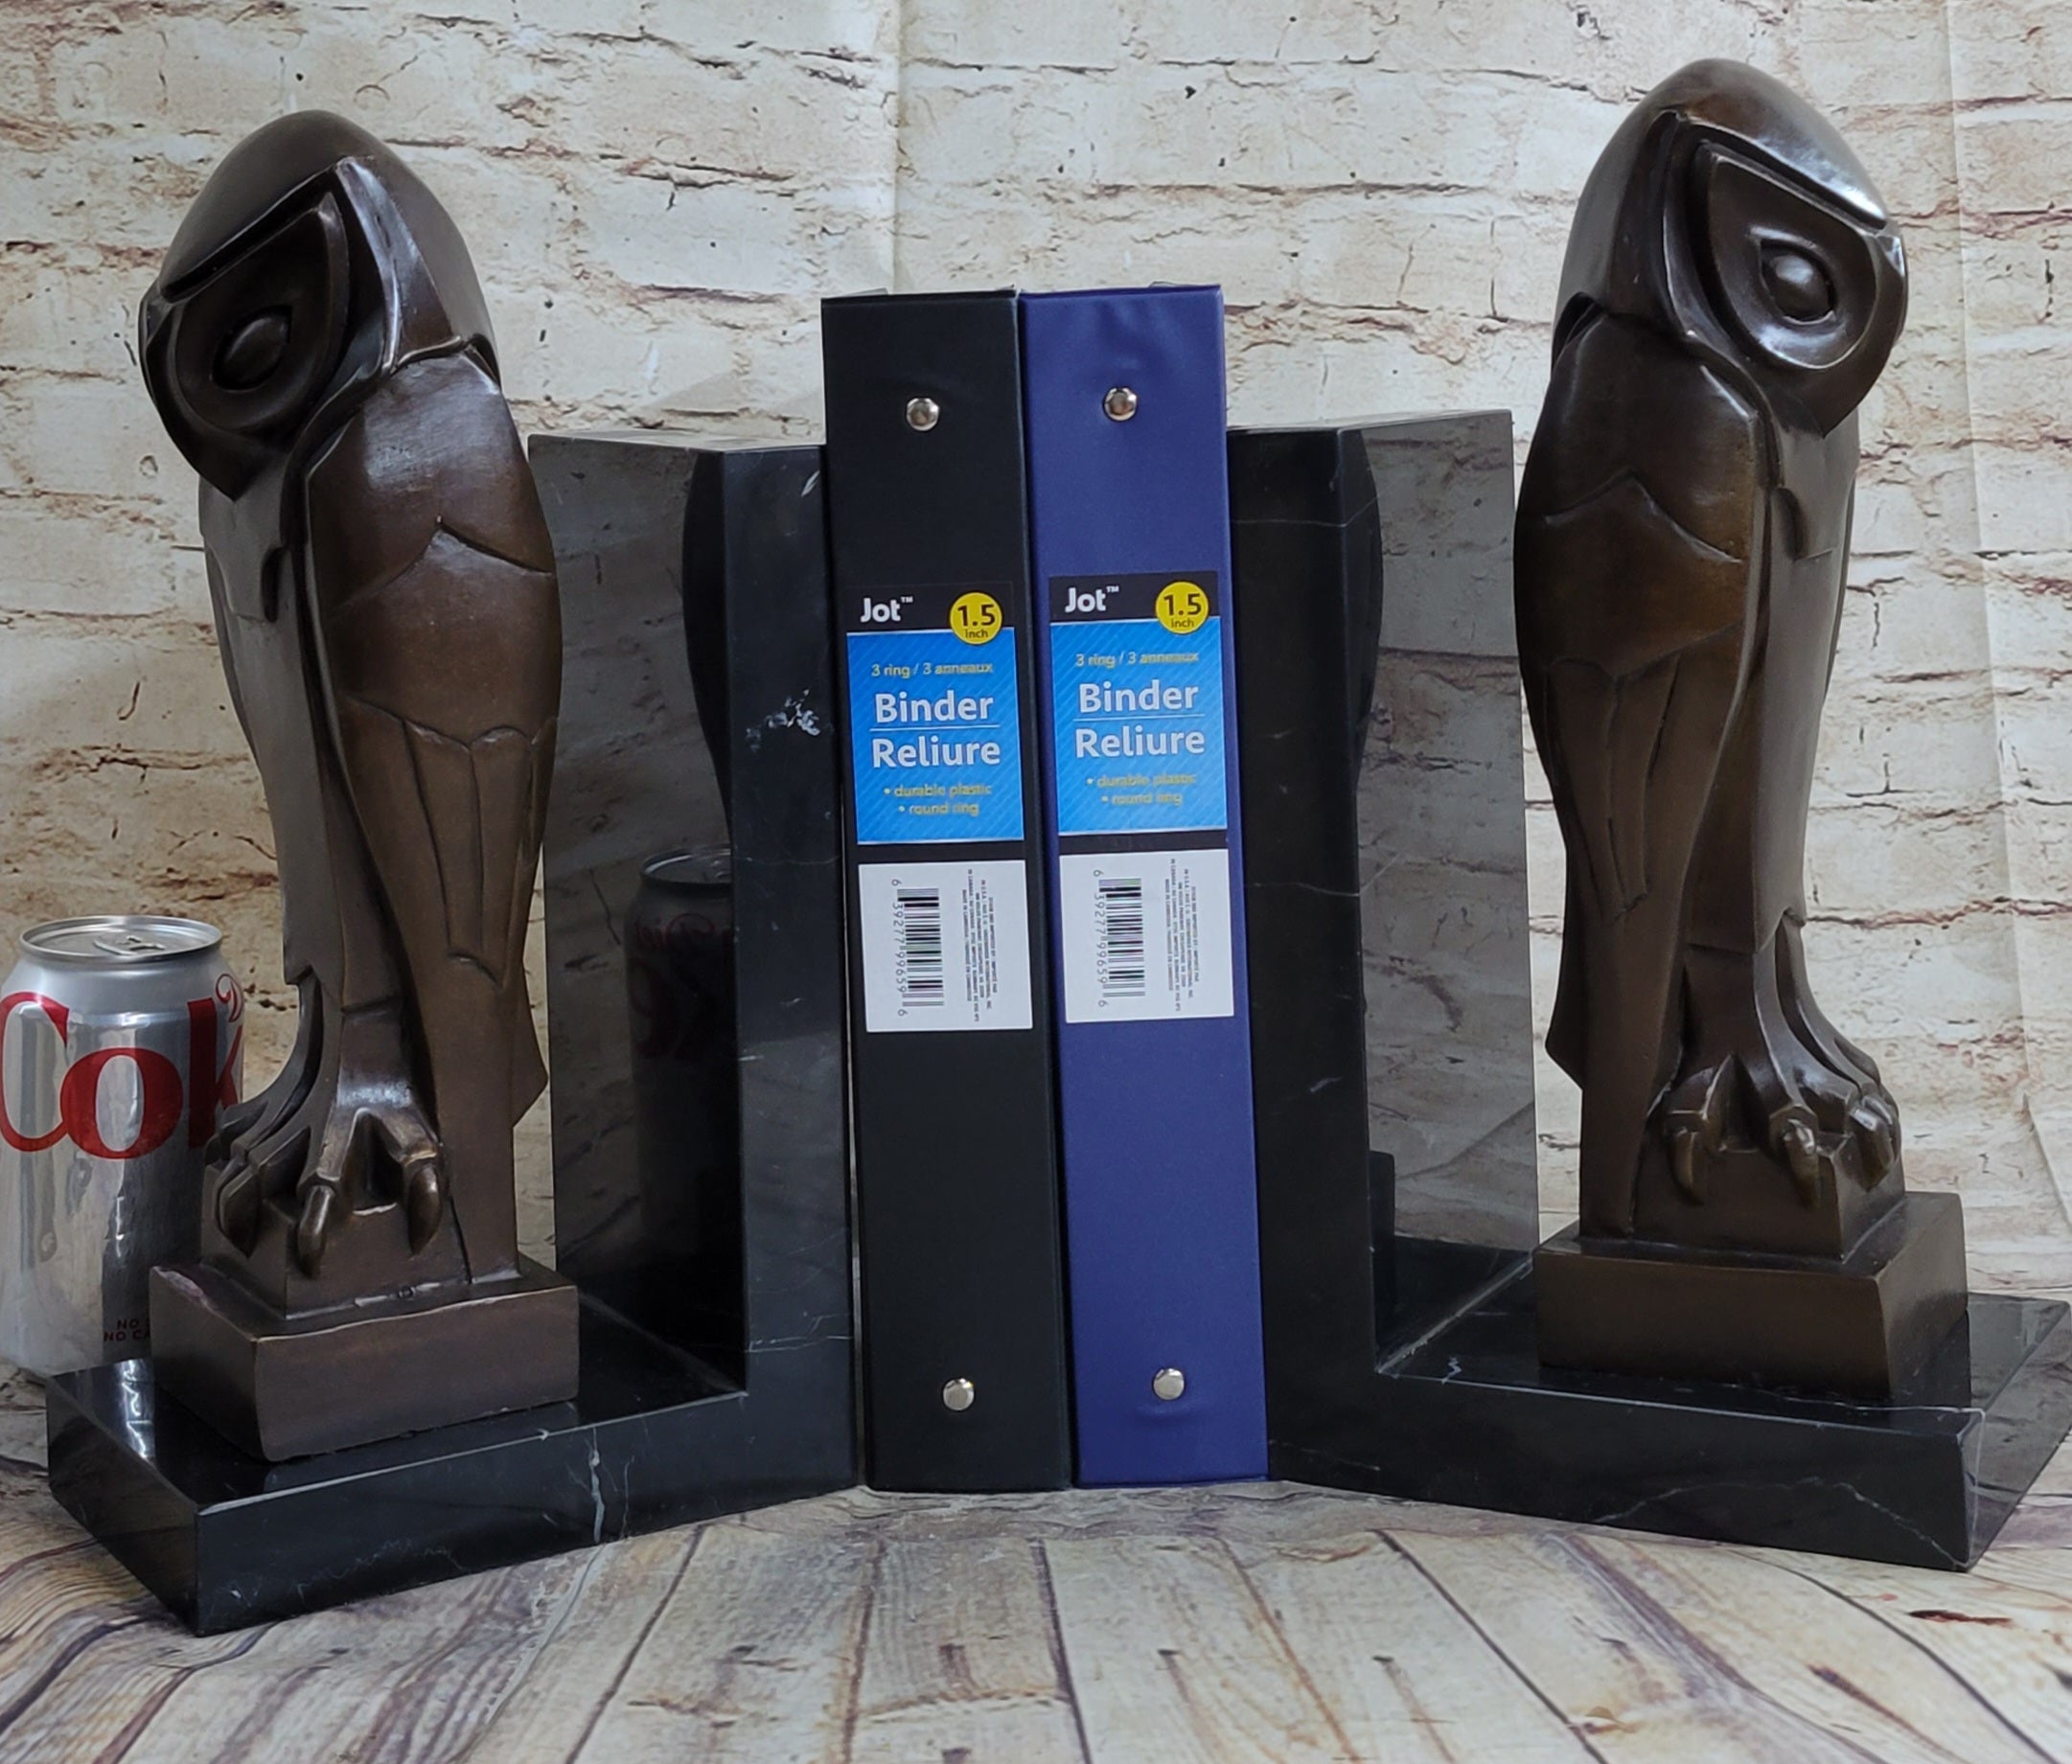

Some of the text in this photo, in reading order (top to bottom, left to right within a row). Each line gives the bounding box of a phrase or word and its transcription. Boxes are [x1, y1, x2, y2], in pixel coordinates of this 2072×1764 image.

[956, 604, 997, 627] 1.5
[1163, 593, 1203, 617] 1.5
[964, 629, 989, 639] inch
[1170, 618, 1195, 629] inch
[871, 663, 882, 677] 3
[884, 663, 910, 679] ring
[923, 662, 932, 676] 3
[1075, 653, 1085, 667] 3
[1128, 652, 1137, 665] 3
[875, 690, 994, 723] Binder
[1078, 679, 1199, 714] Binder
[872, 735, 1001, 768] Reliure
[1075, 725, 1205, 759] Reliure
[891, 879, 903, 887] 6
[892, 903, 906, 944] 39277
[1094, 893, 1107, 935] 39277
[895, 951, 908, 993] 99659
[117, 1318, 139, 1330] NO
[104, 1331, 127, 1342] NO
